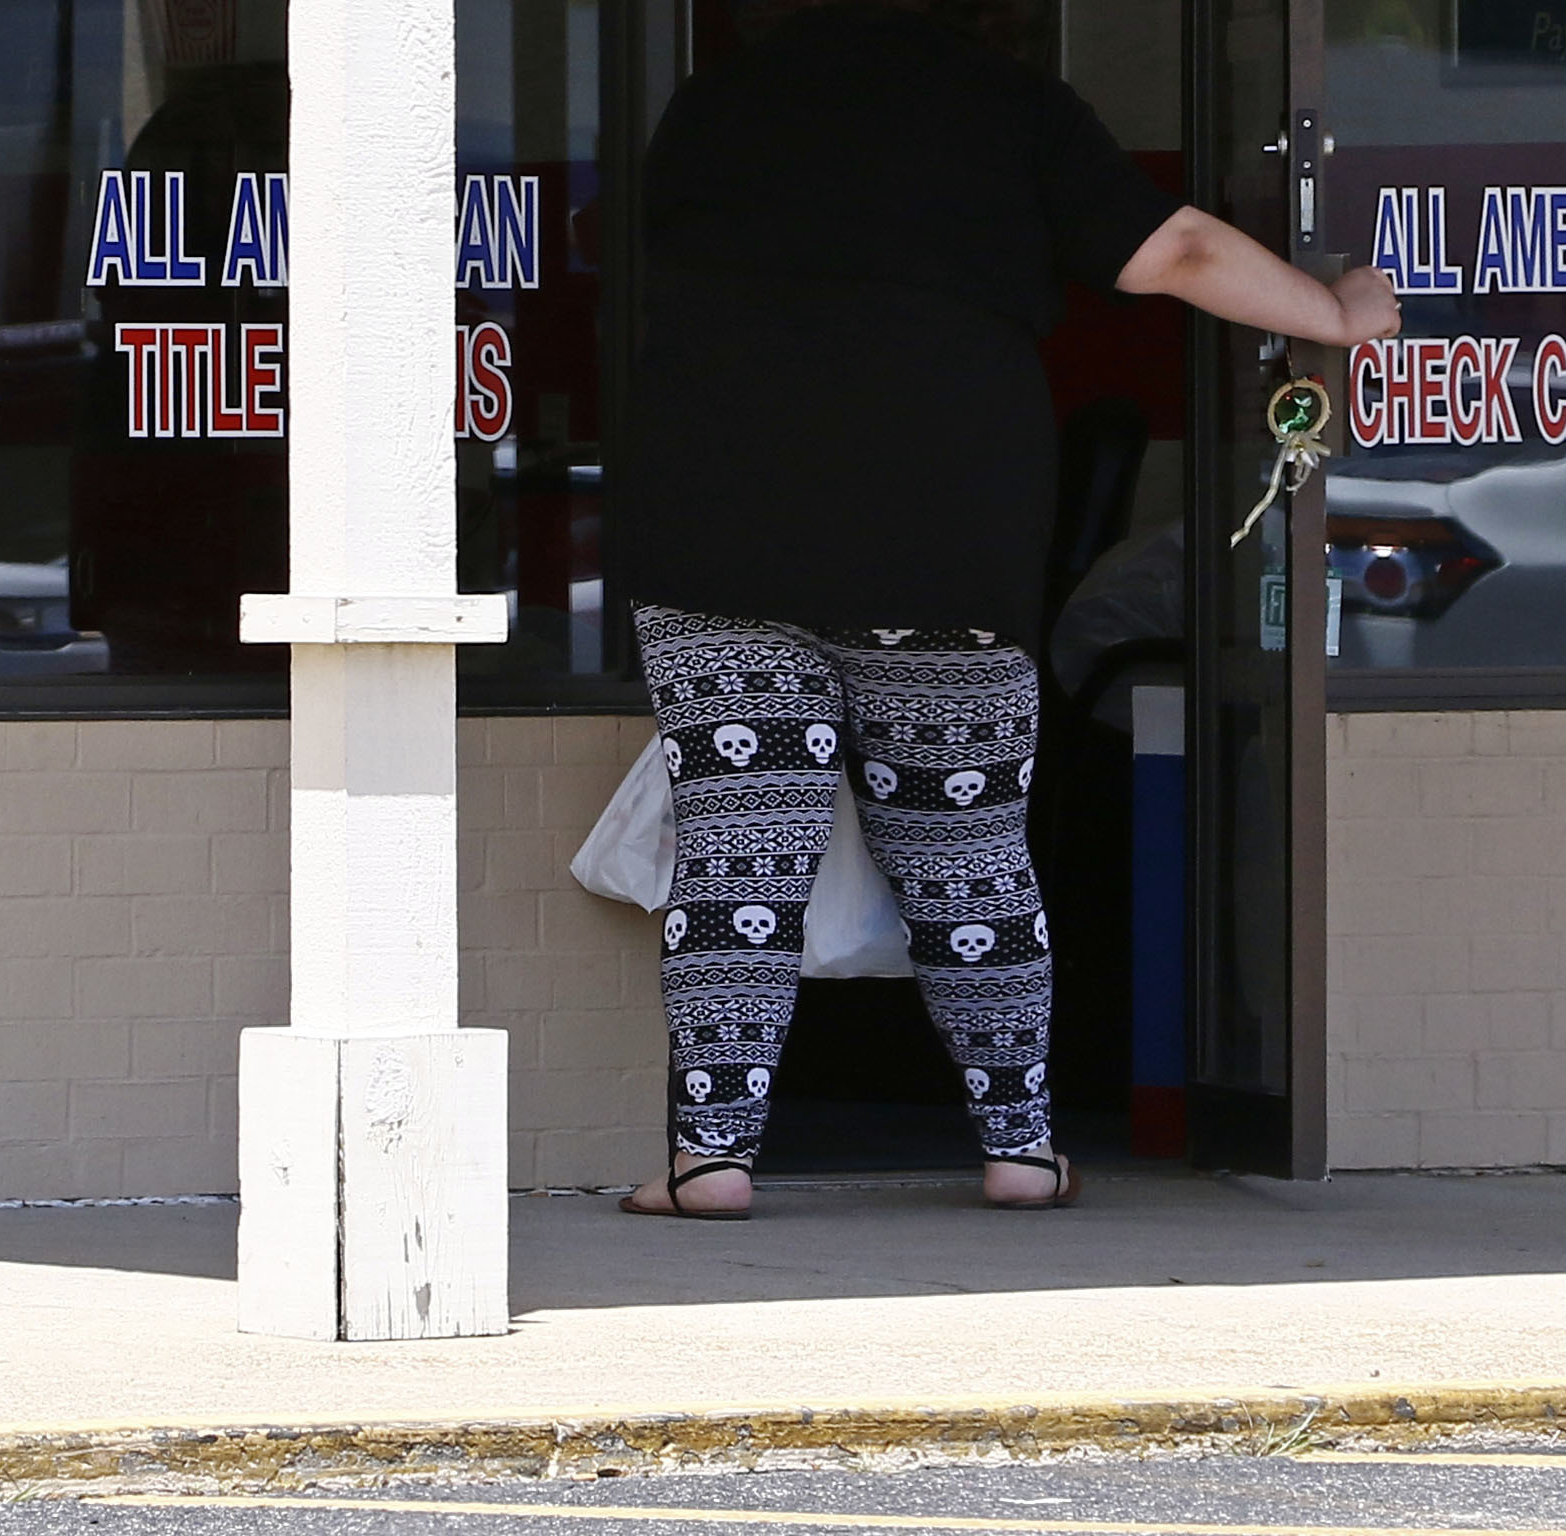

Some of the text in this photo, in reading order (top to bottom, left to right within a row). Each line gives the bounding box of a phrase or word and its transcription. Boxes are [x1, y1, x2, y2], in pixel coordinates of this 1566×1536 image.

[86, 170, 206, 287] ALL
[1371, 186, 1463, 295] ALL
[115, 322, 284, 438] TITLE
[1350, 334, 1523, 448] CHECK
